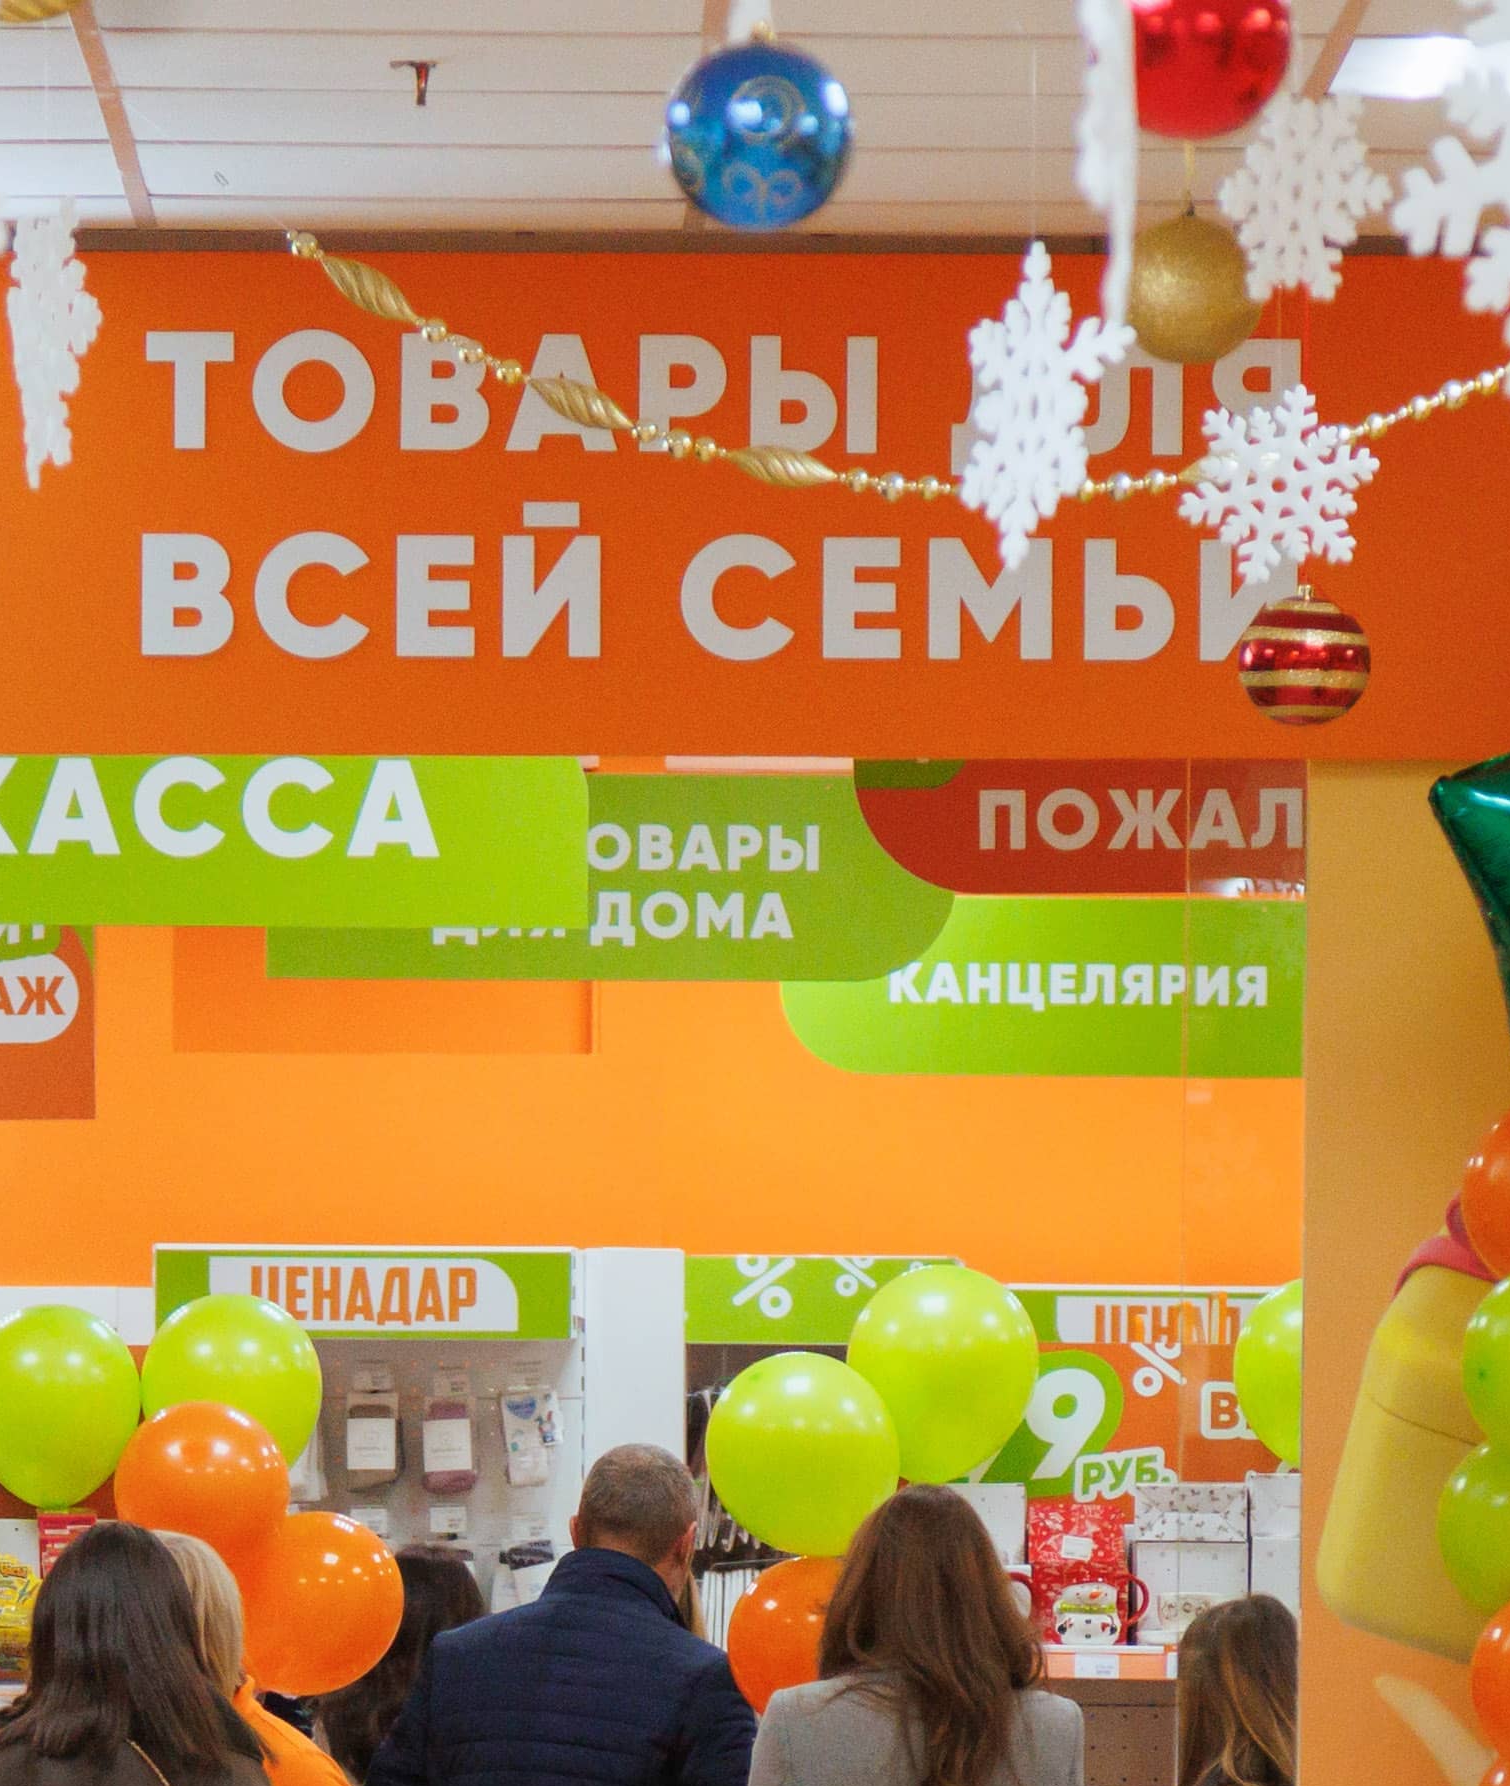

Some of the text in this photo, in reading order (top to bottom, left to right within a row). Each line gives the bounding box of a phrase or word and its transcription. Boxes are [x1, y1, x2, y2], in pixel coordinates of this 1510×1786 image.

[147, 329, 1302, 476] ТОВАРЫ ЛЯ
[139, 502, 603, 661] ВСЕЙ
[979, 788, 1303, 850] ПОЖАЛ
[590, 892, 794, 946] ДОМА
[888, 962, 1268, 1012] КАНЦЕЛЯРИЯ
[251, 1265, 477, 1325] ЦЕНАДАР
